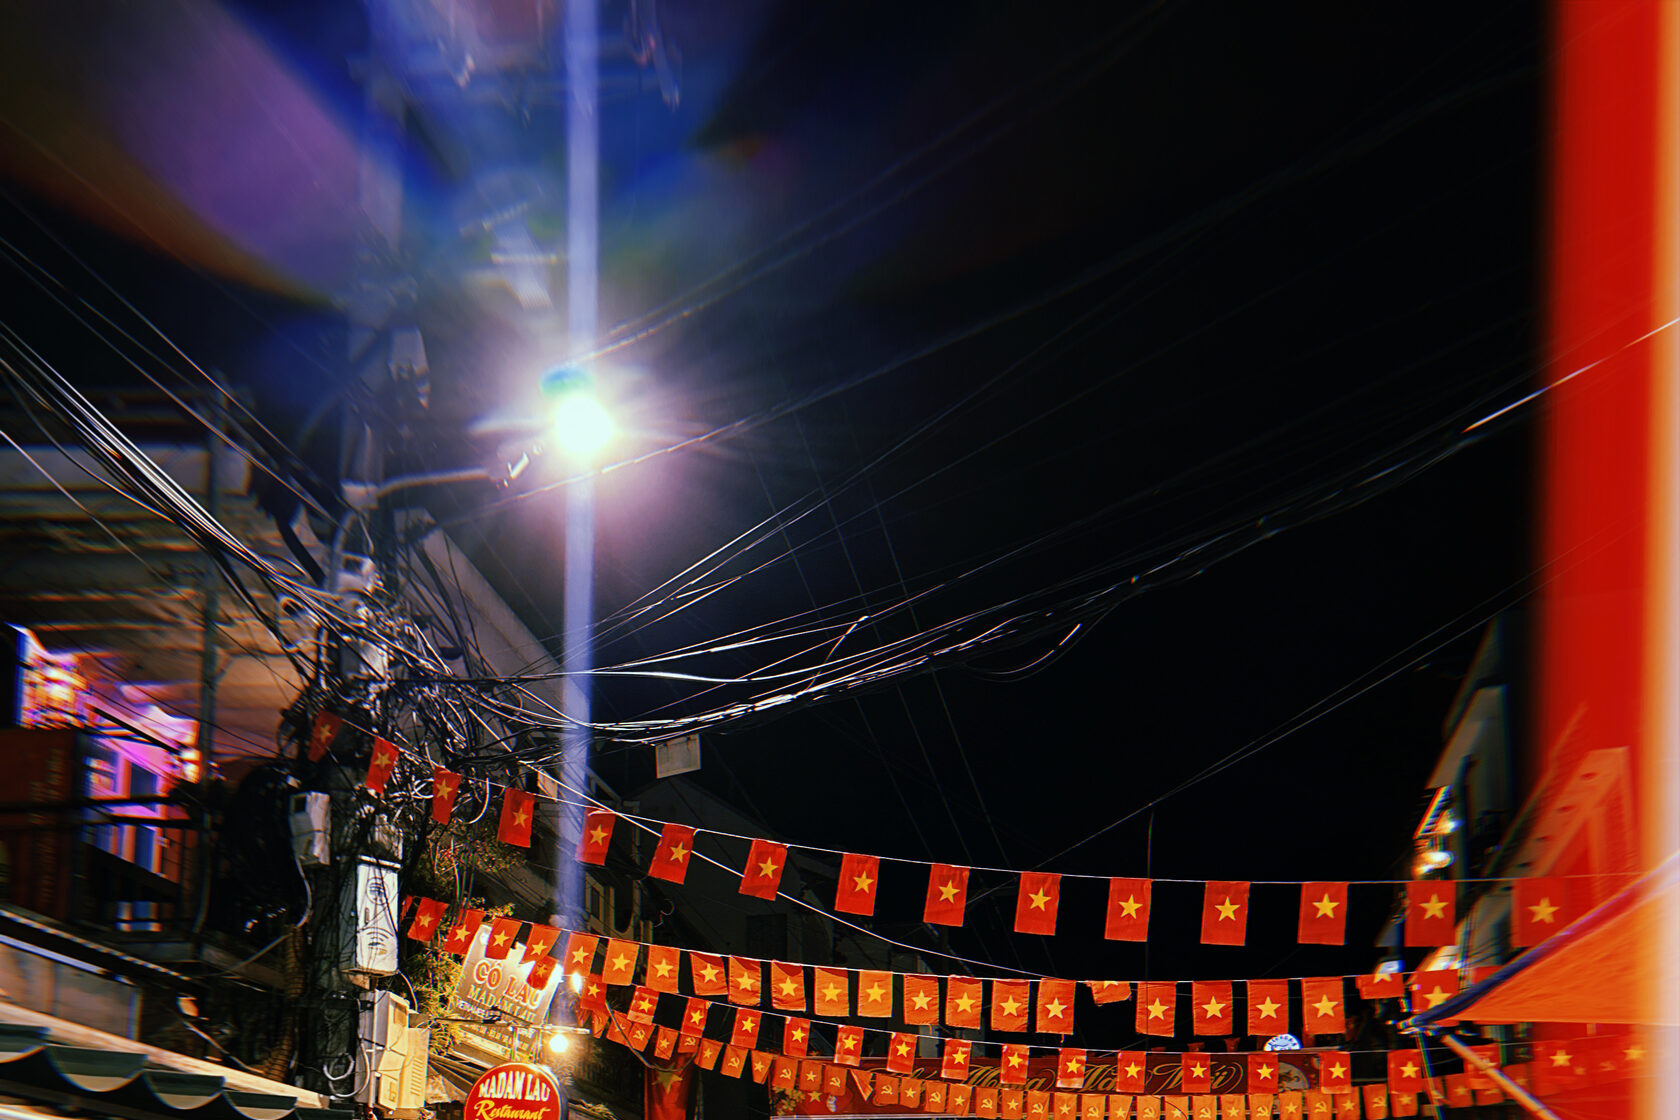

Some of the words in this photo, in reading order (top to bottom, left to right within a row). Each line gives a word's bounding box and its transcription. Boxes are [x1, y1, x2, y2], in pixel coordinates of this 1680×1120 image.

[467, 984, 513, 1013] MADAM
[512, 1006, 537, 1023] LAU
[478, 1071, 526, 1100] MADAM
[525, 1074, 551, 1102] LAU
